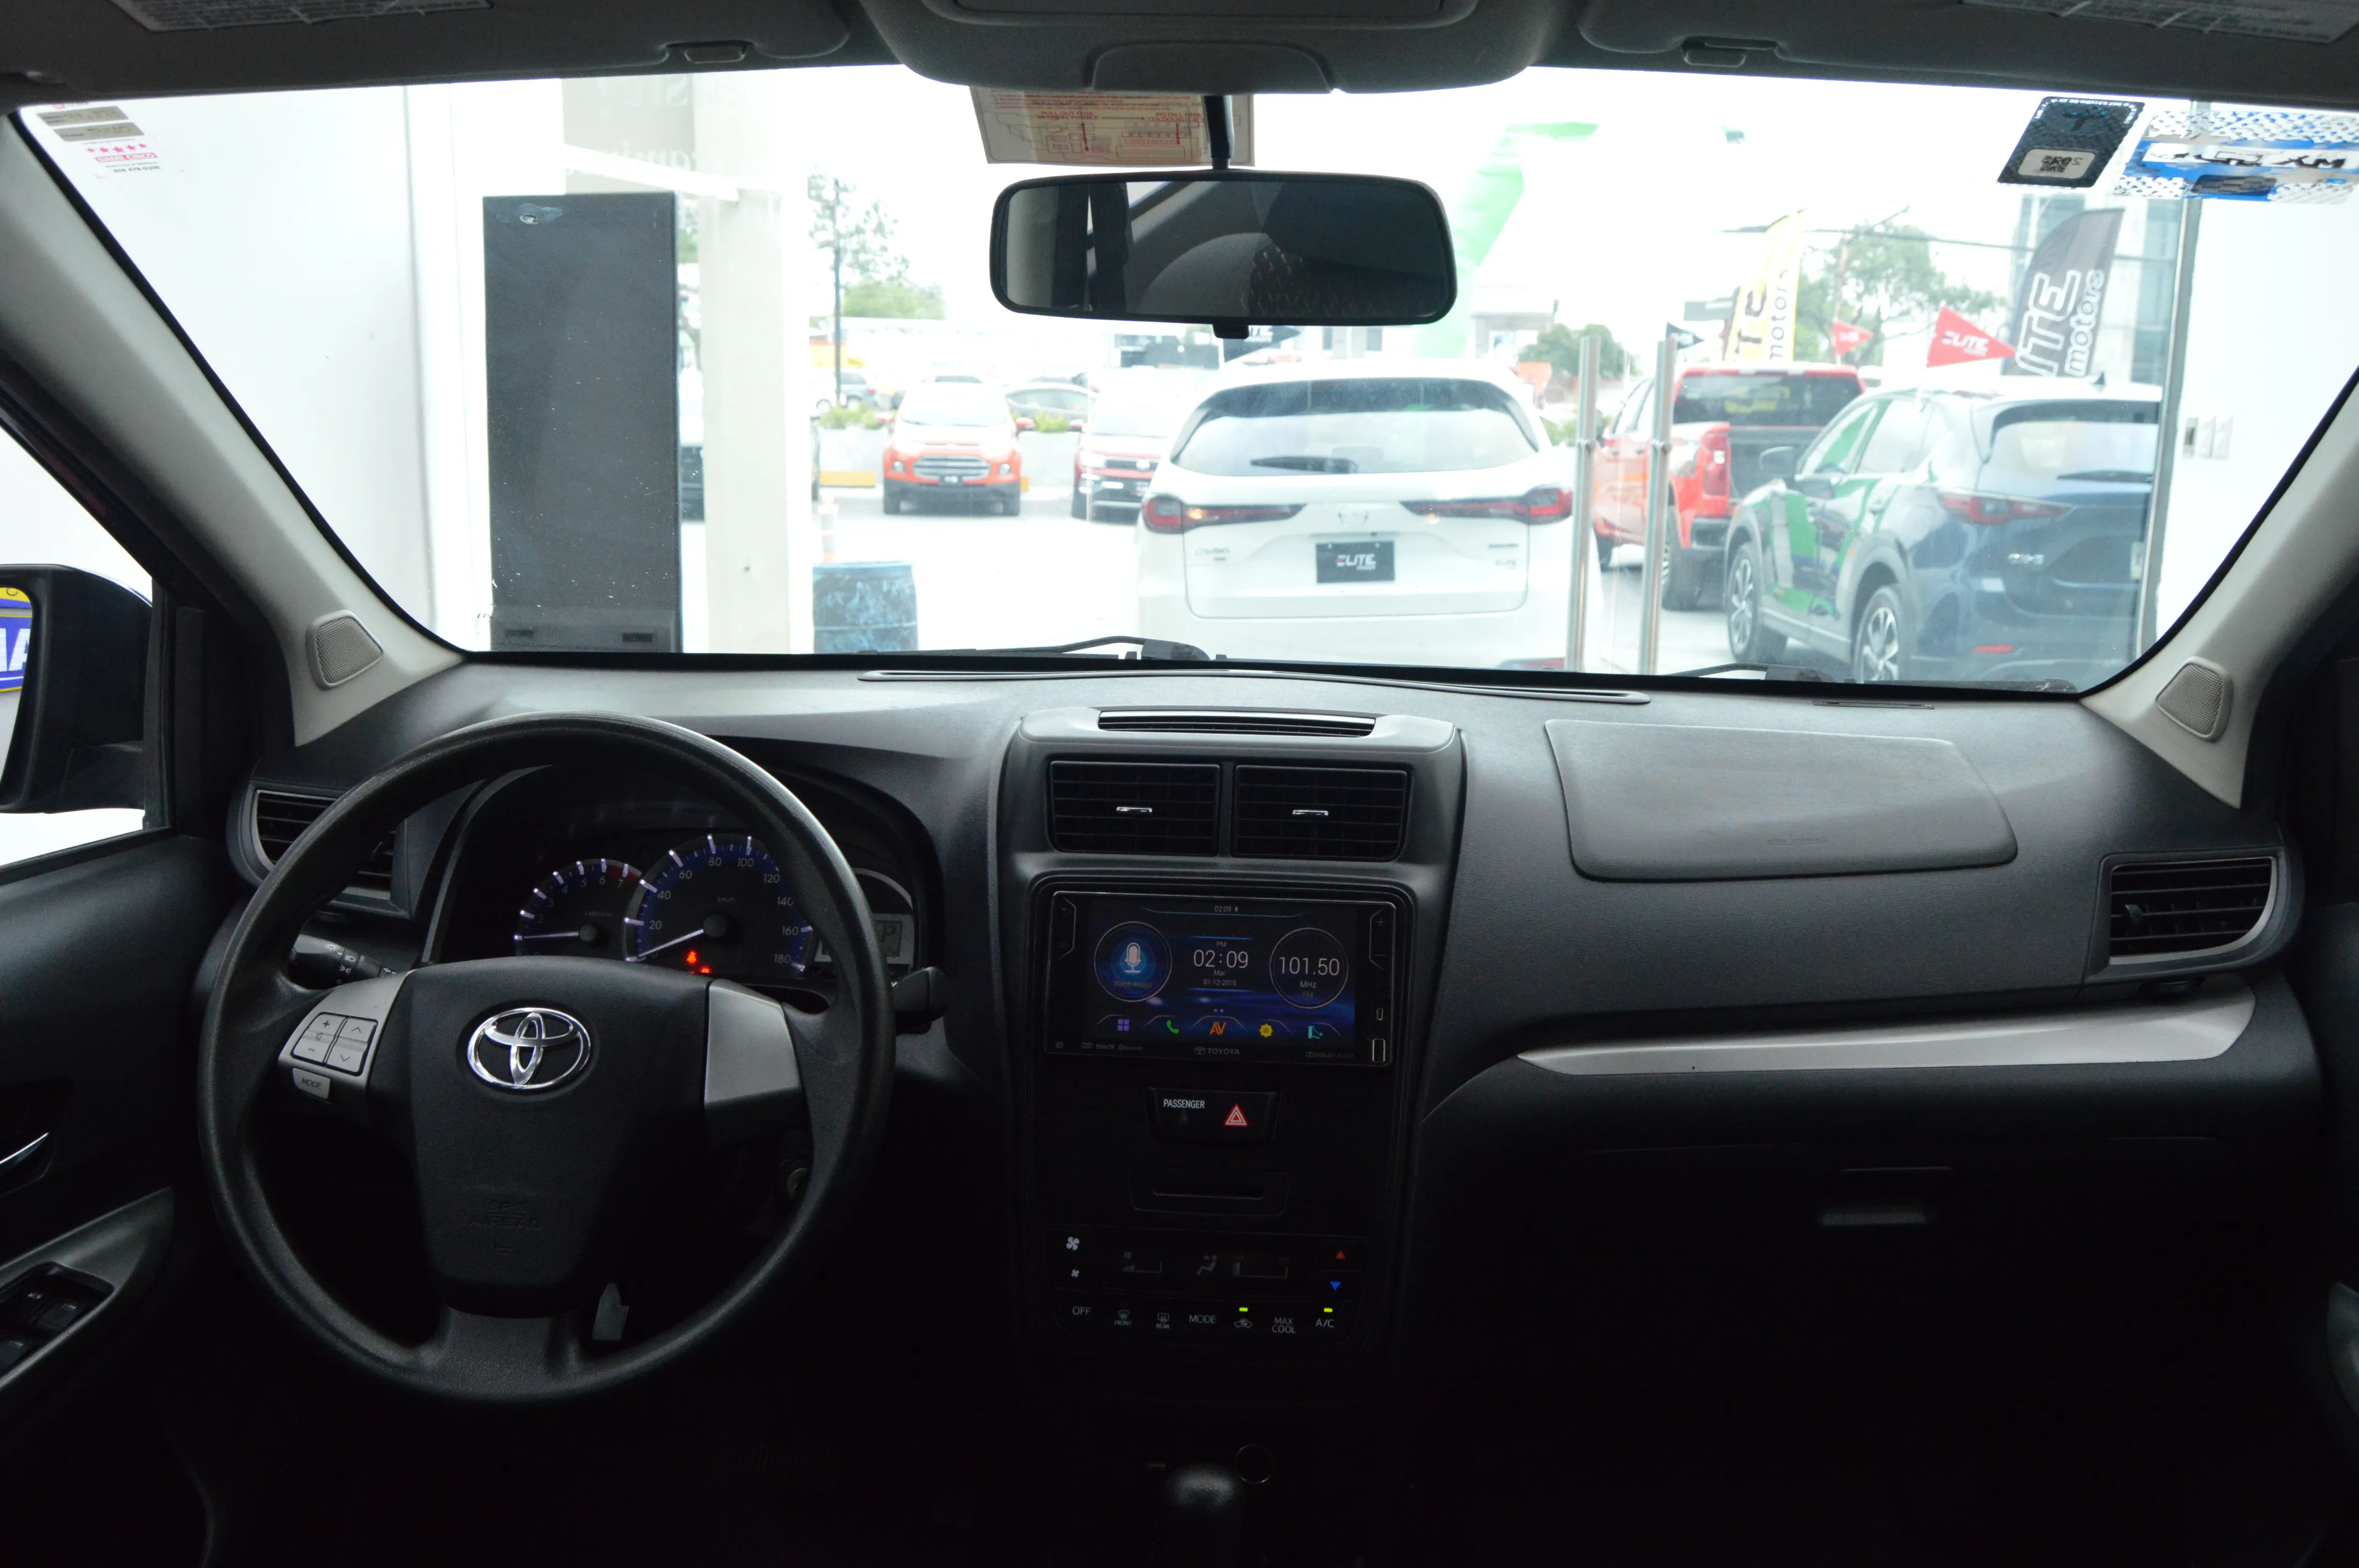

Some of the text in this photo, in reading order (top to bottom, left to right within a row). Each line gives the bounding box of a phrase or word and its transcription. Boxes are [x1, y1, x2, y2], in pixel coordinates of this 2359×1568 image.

[2064, 269, 2104, 377] motors
[1335, 554, 1376, 567] ELITE
[708, 857, 722, 867] 80
[737, 858, 754, 867] 100
[679, 870, 692, 879] 60
[763, 874, 780, 883] 120
[580, 879, 587, 887] 5
[599, 876, 605, 884] 6
[617, 879, 623, 888] 7
[562, 885, 568, 894] 4
[657, 891, 671, 900] 40
[547, 898, 554, 907] 3
[777, 897, 794, 906] 140
[537, 915, 544, 924] 2
[649, 920, 662, 930] 20
[782, 926, 798, 935] 160
[774, 954, 791, 963] 180
[1194, 949, 1249, 969] 02:09
[1279, 956, 1340, 976] 101.50
[1209, 1021, 1227, 1035] AV
[1207, 1047, 1240, 1055] TOYOTA
[302, 1078, 323, 1089] MODE
[1163, 1098, 1205, 1109] PASSENGER
[1072, 1307, 1091, 1316] OFF
[1189, 1315, 1217, 1324] MODE
[1315, 1319, 1334, 1328] A/C
[1272, 1325, 1296, 1334] COOL
